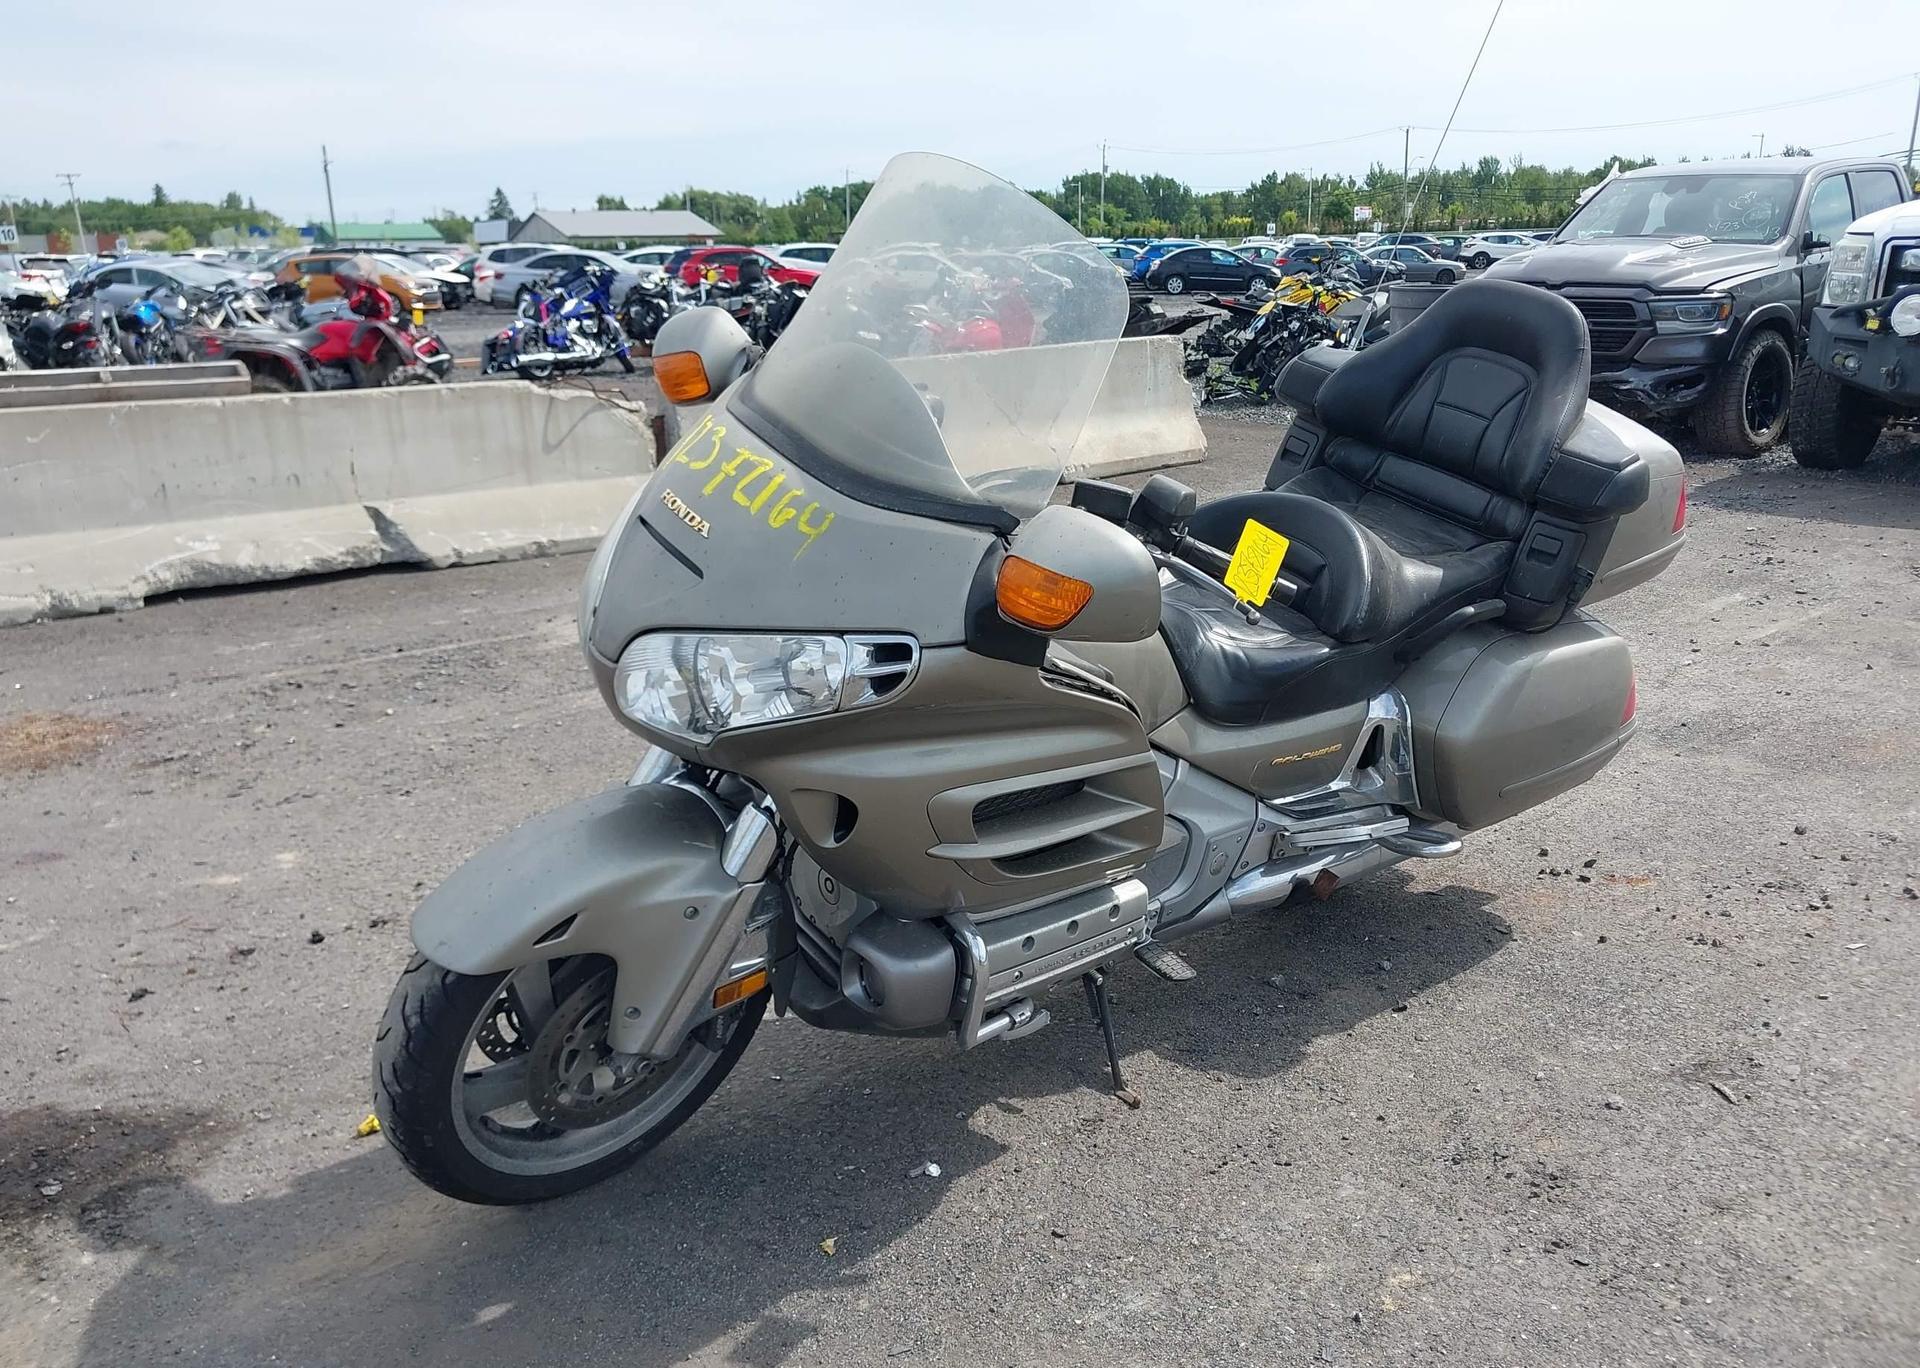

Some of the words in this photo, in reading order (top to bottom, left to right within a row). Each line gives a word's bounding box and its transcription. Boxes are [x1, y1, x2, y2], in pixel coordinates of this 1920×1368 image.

[1, 229, 15, 241] 10
[660, 488, 711, 538] HONDA
[1271, 744, 1342, 761] GOLDWING
